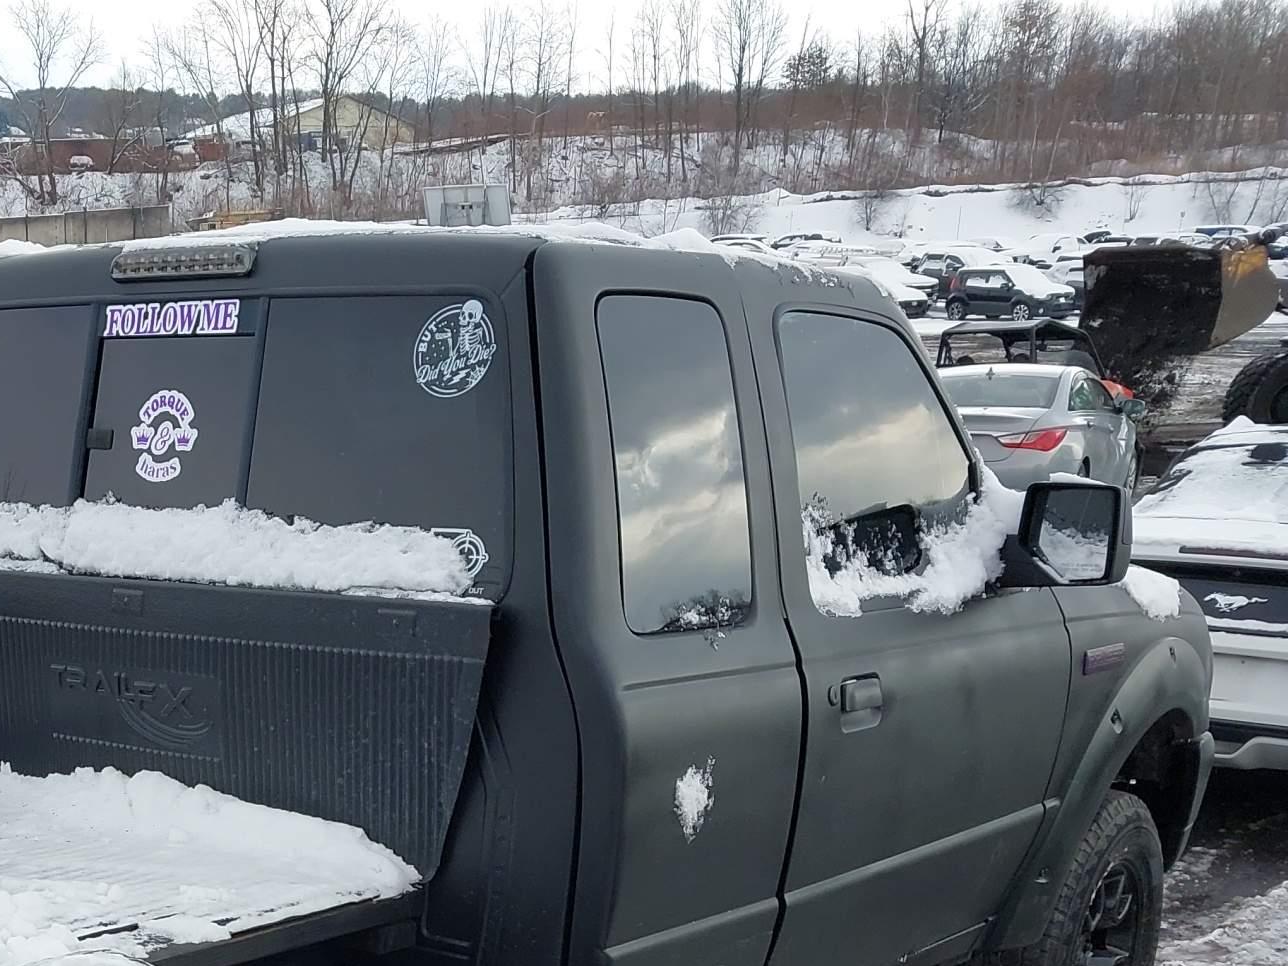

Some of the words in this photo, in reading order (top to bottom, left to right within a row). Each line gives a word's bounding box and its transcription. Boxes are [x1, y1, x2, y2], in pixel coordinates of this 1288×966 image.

[104, 302, 199, 336] FOLLOW
[197, 299, 240, 334] ME
[417, 361, 442, 383] Did
[441, 356, 468, 381] You
[467, 343, 496, 365] Die?
[143, 395, 189, 421] TORQUE
[154, 426, 171, 451] &
[468, 587, 485, 595] OUT
